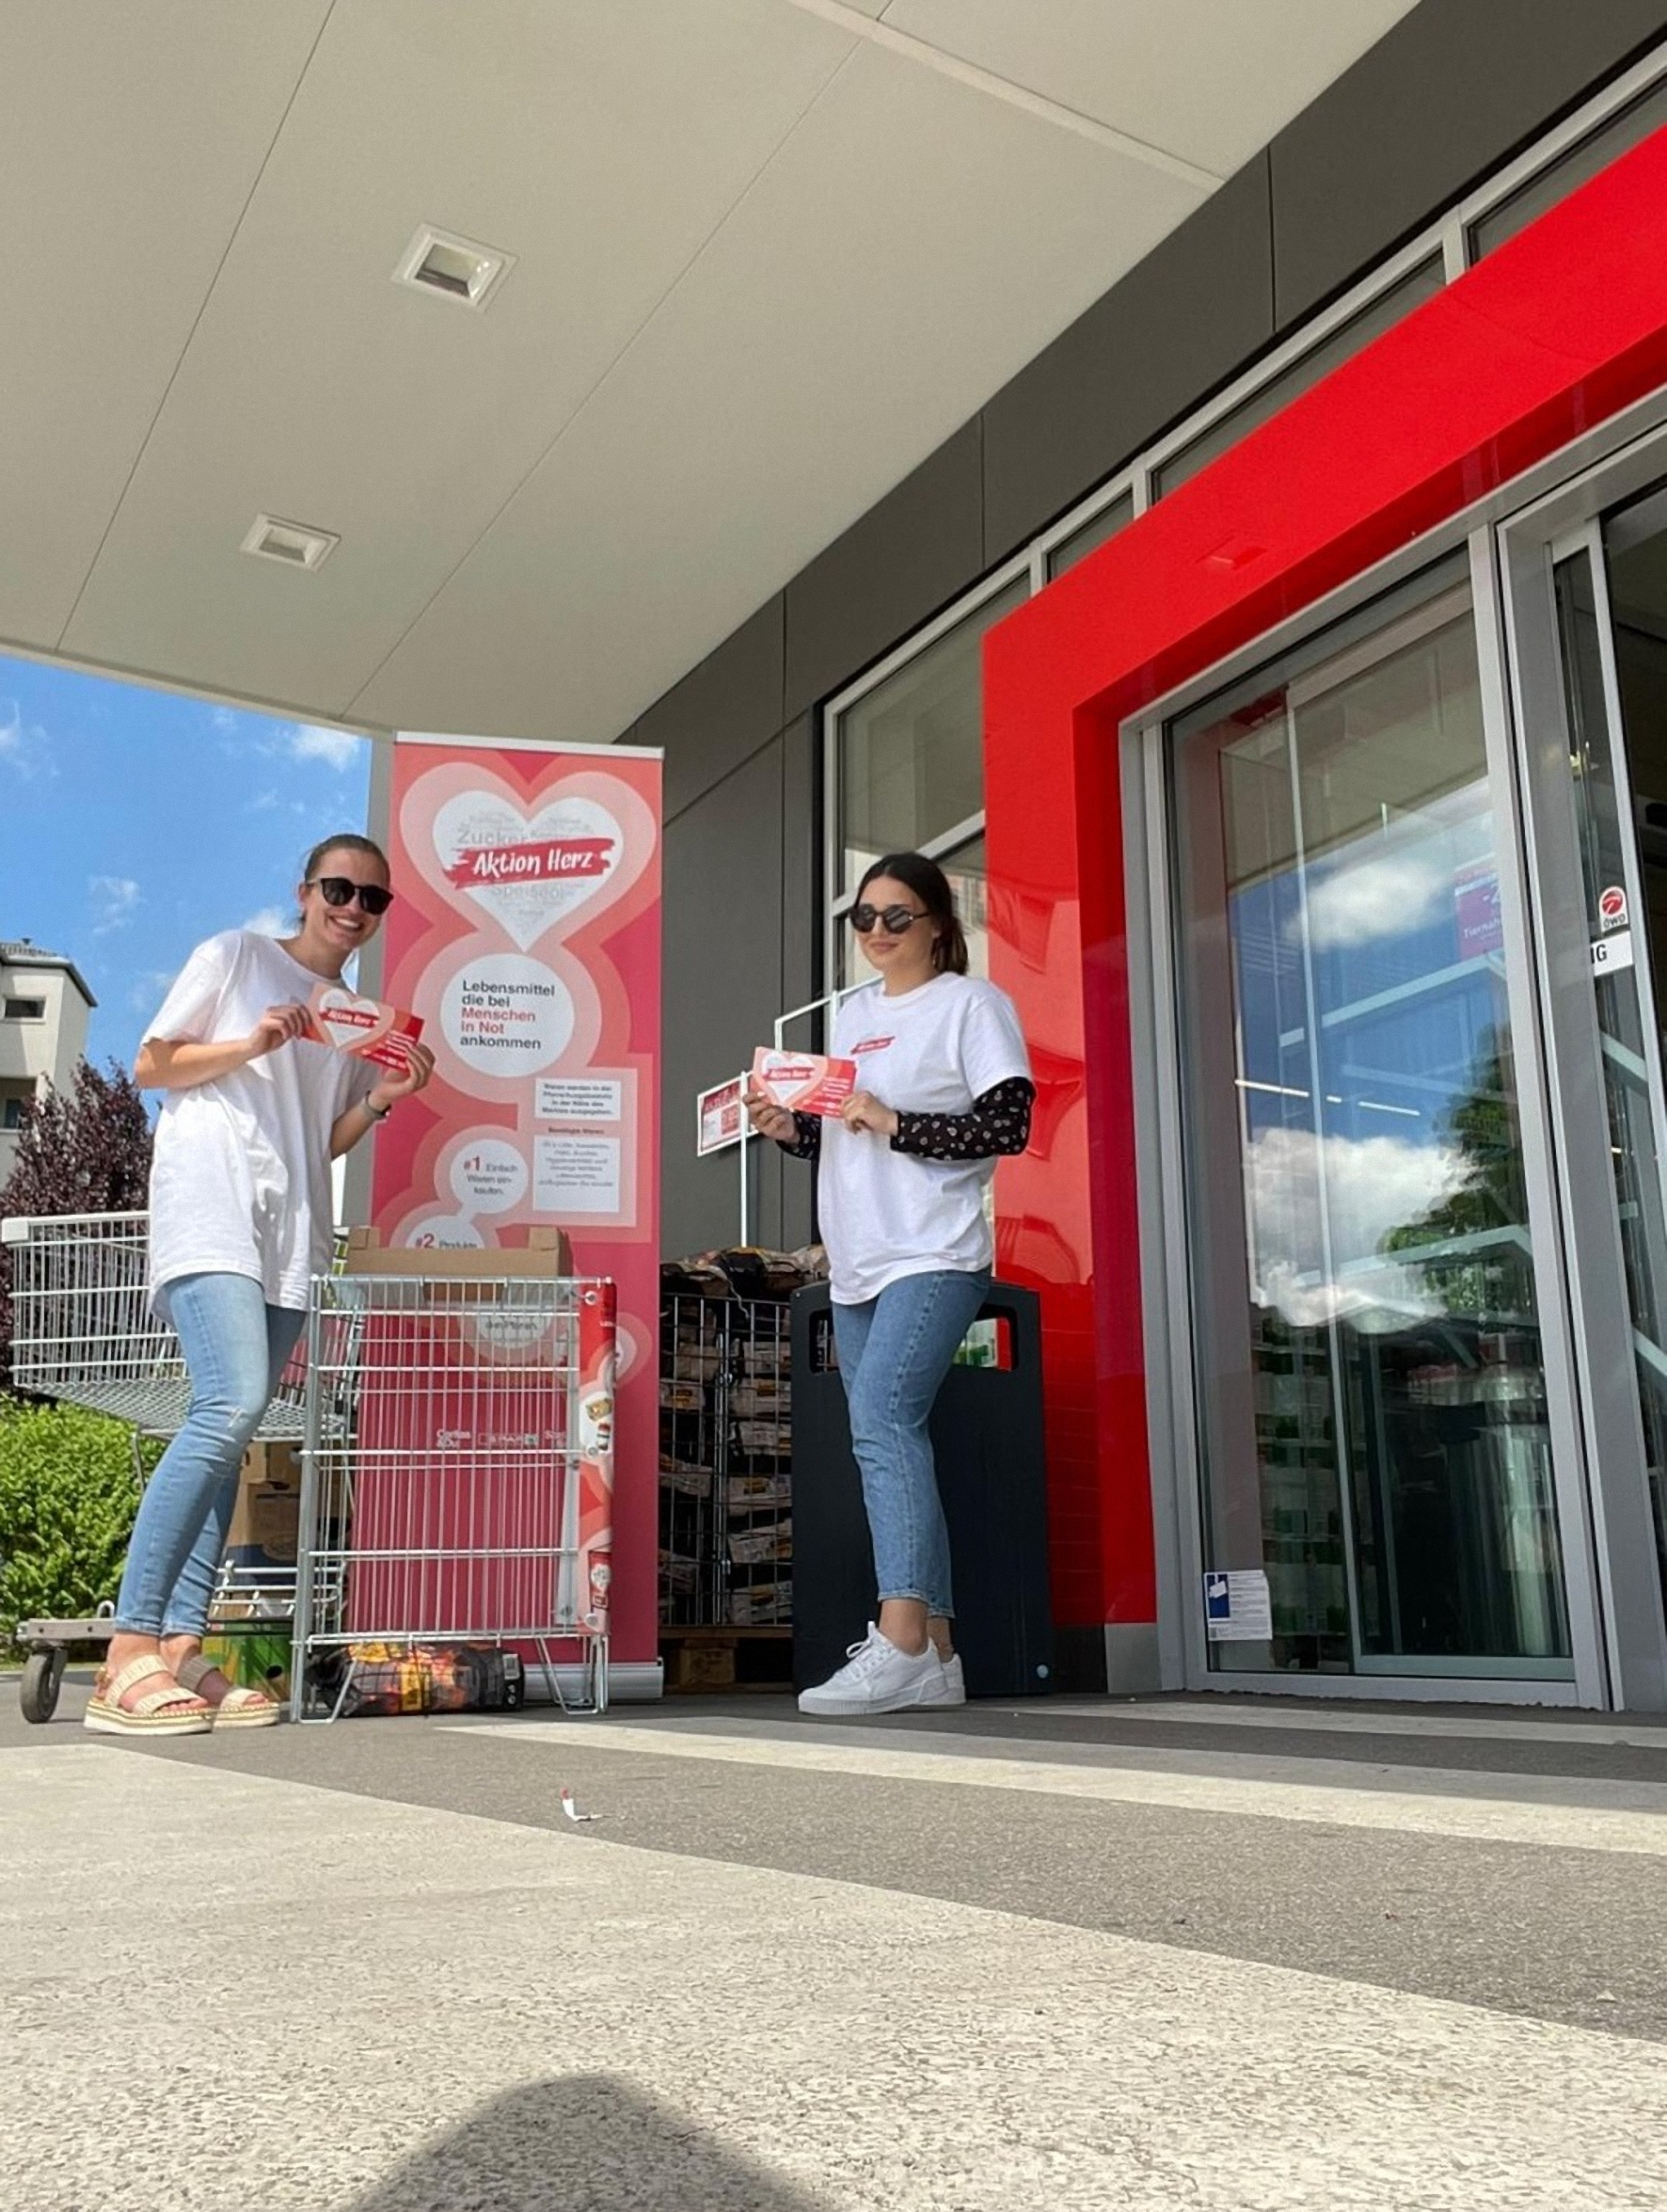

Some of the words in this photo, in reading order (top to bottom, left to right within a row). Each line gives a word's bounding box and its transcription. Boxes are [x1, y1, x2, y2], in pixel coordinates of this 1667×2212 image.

[473, 851, 541, 879] Aktion
[548, 848, 594, 871] Herz
[463, 979, 555, 996] Lebensmittel
[461, 994, 484, 1006] die
[488, 995, 510, 1008] bei
[461, 1007, 536, 1022] Menschen
[461, 1021, 474, 1033] in
[479, 1021, 504, 1035] Not
[460, 1035, 541, 1049] ankommen
